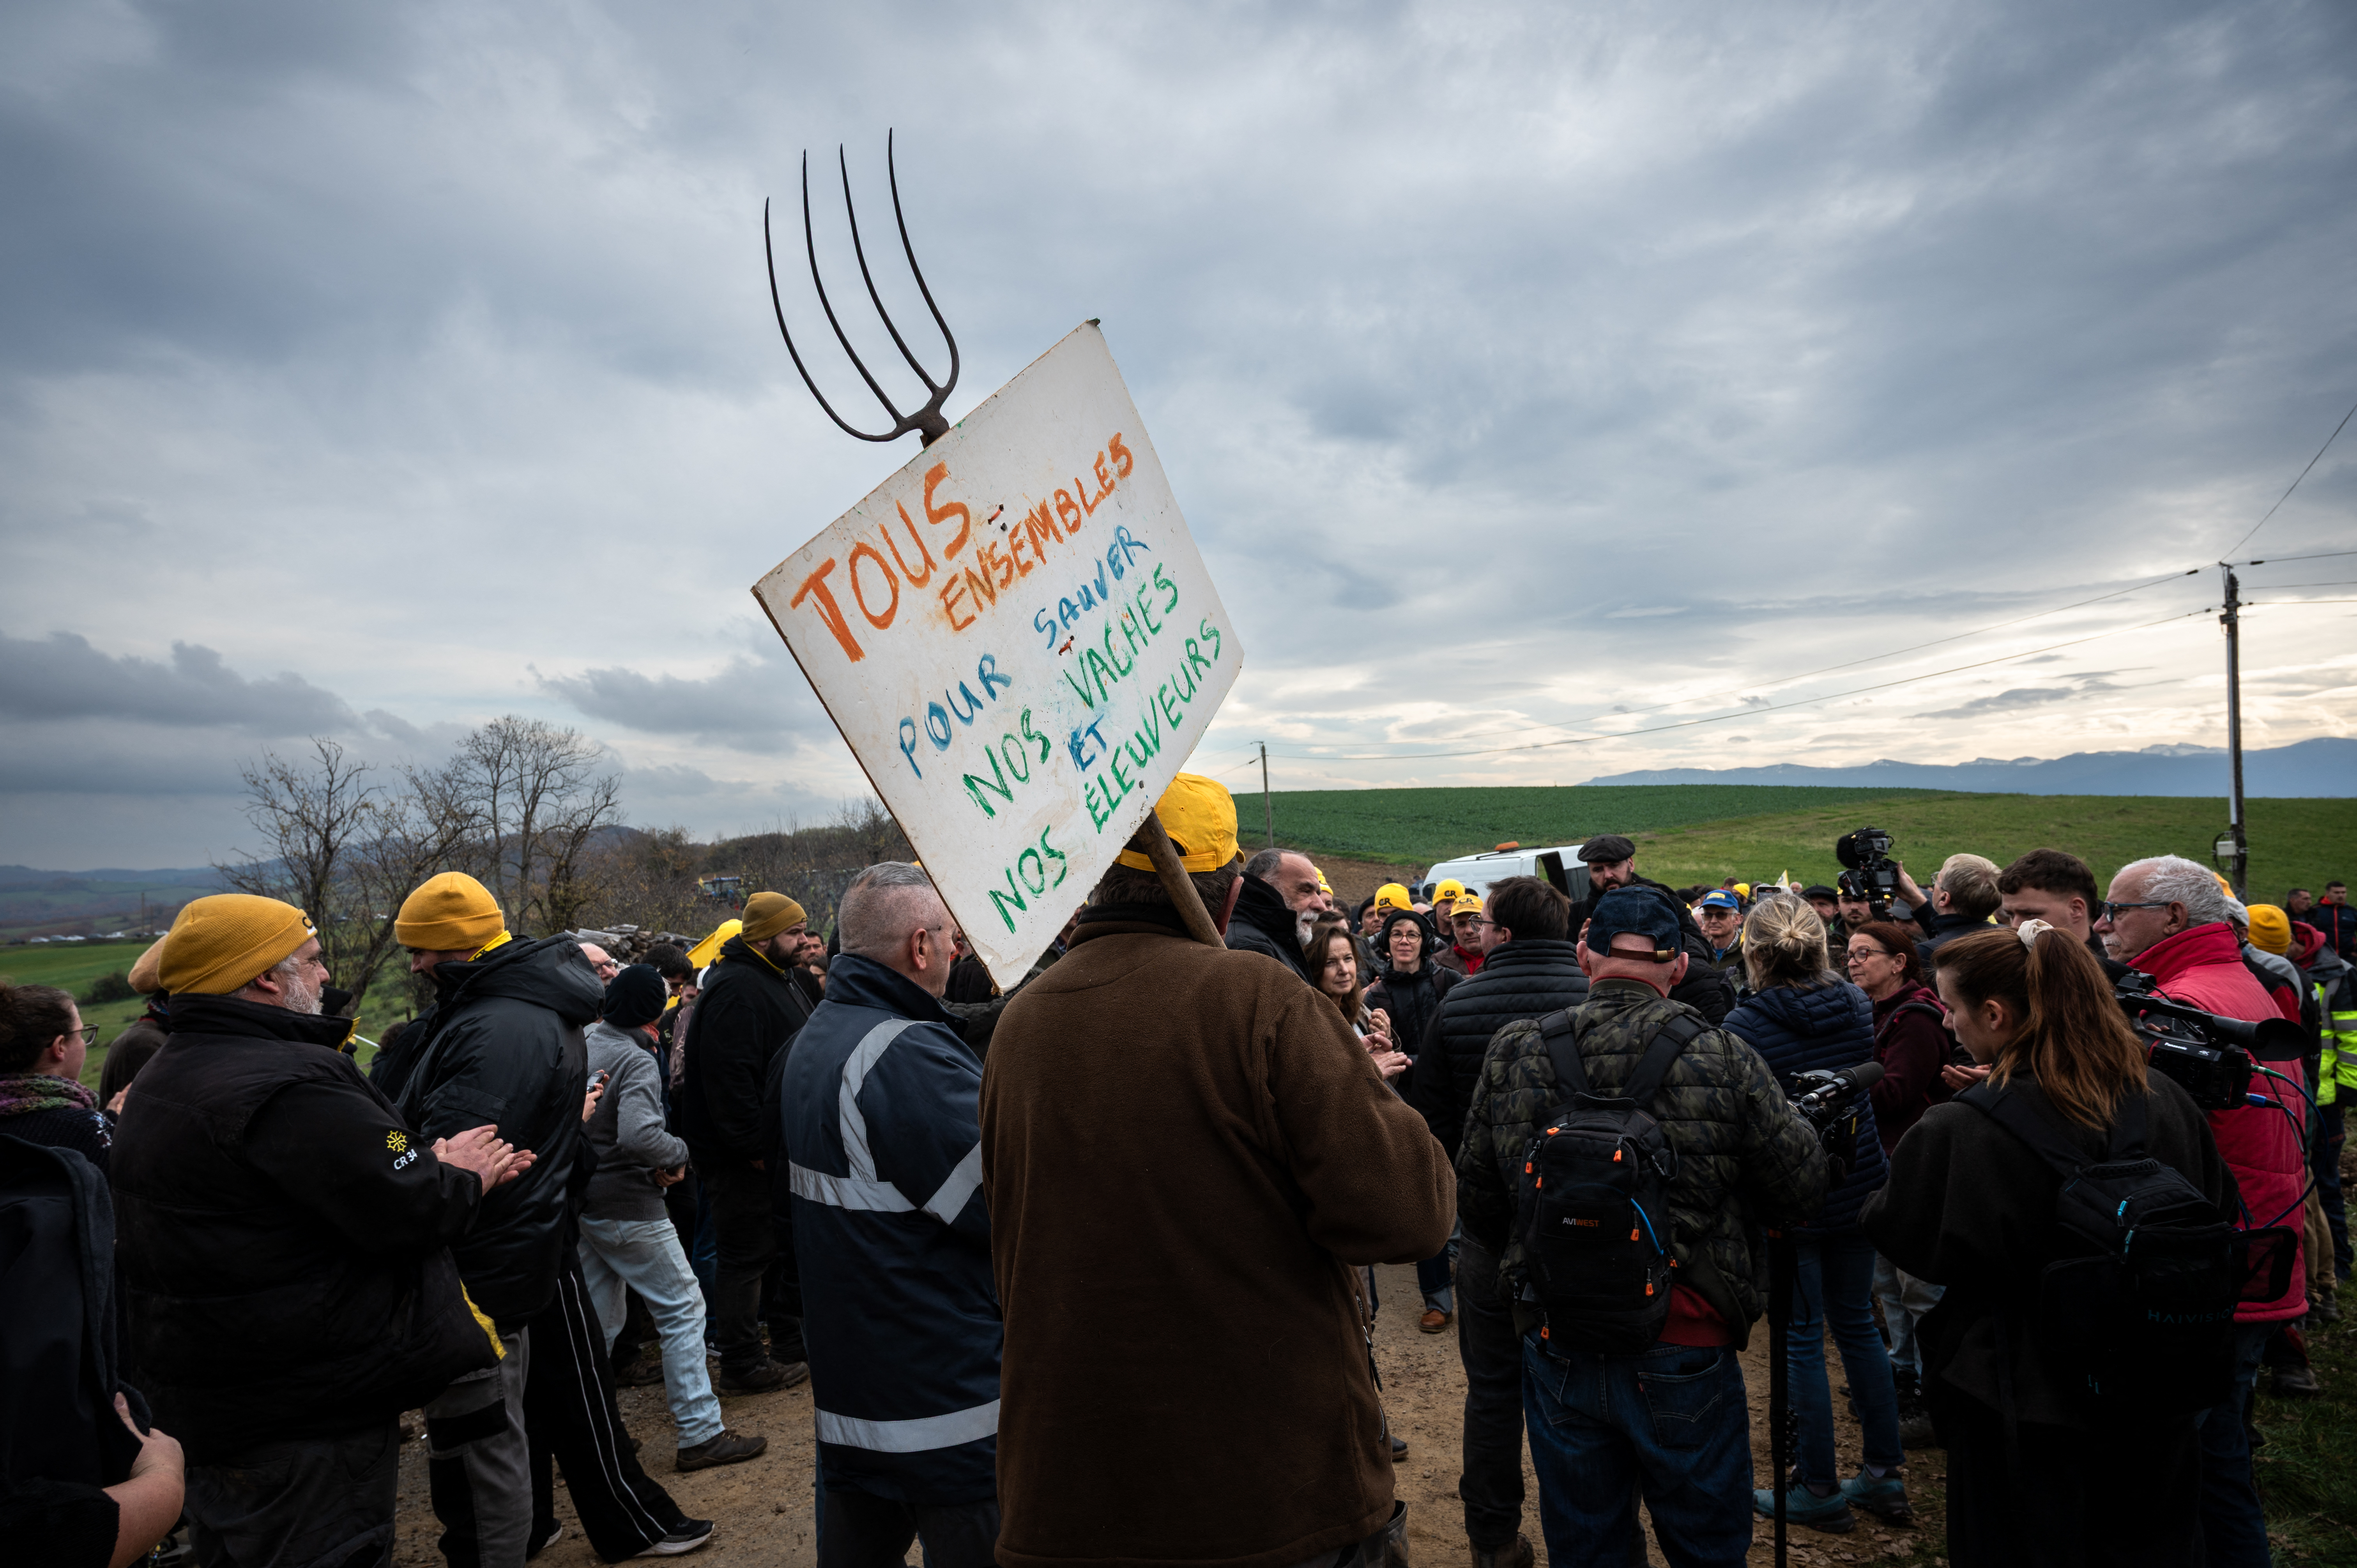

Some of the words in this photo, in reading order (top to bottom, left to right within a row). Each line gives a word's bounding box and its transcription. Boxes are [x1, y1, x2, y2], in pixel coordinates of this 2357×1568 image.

[939, 432, 1134, 632] ENSEMBLES
[790, 460, 970, 663] TOUS
[899, 653, 1012, 780] POUR
[1034, 524, 1151, 650] SAUVER
[962, 706, 1051, 819] NOS
[1063, 562, 1178, 711] VACHES
[1067, 714, 1107, 772] ET
[986, 824, 1067, 935] NOS
[1378, 897, 1393, 906] CR
[1444, 890, 1458, 899] CR
[2164, 1042, 2188, 1051] Panasonic
[393, 1156, 408, 1170] CR
[406, 1148, 418, 1162] 34
[1562, 1217, 1600, 1227] AVIWEST
